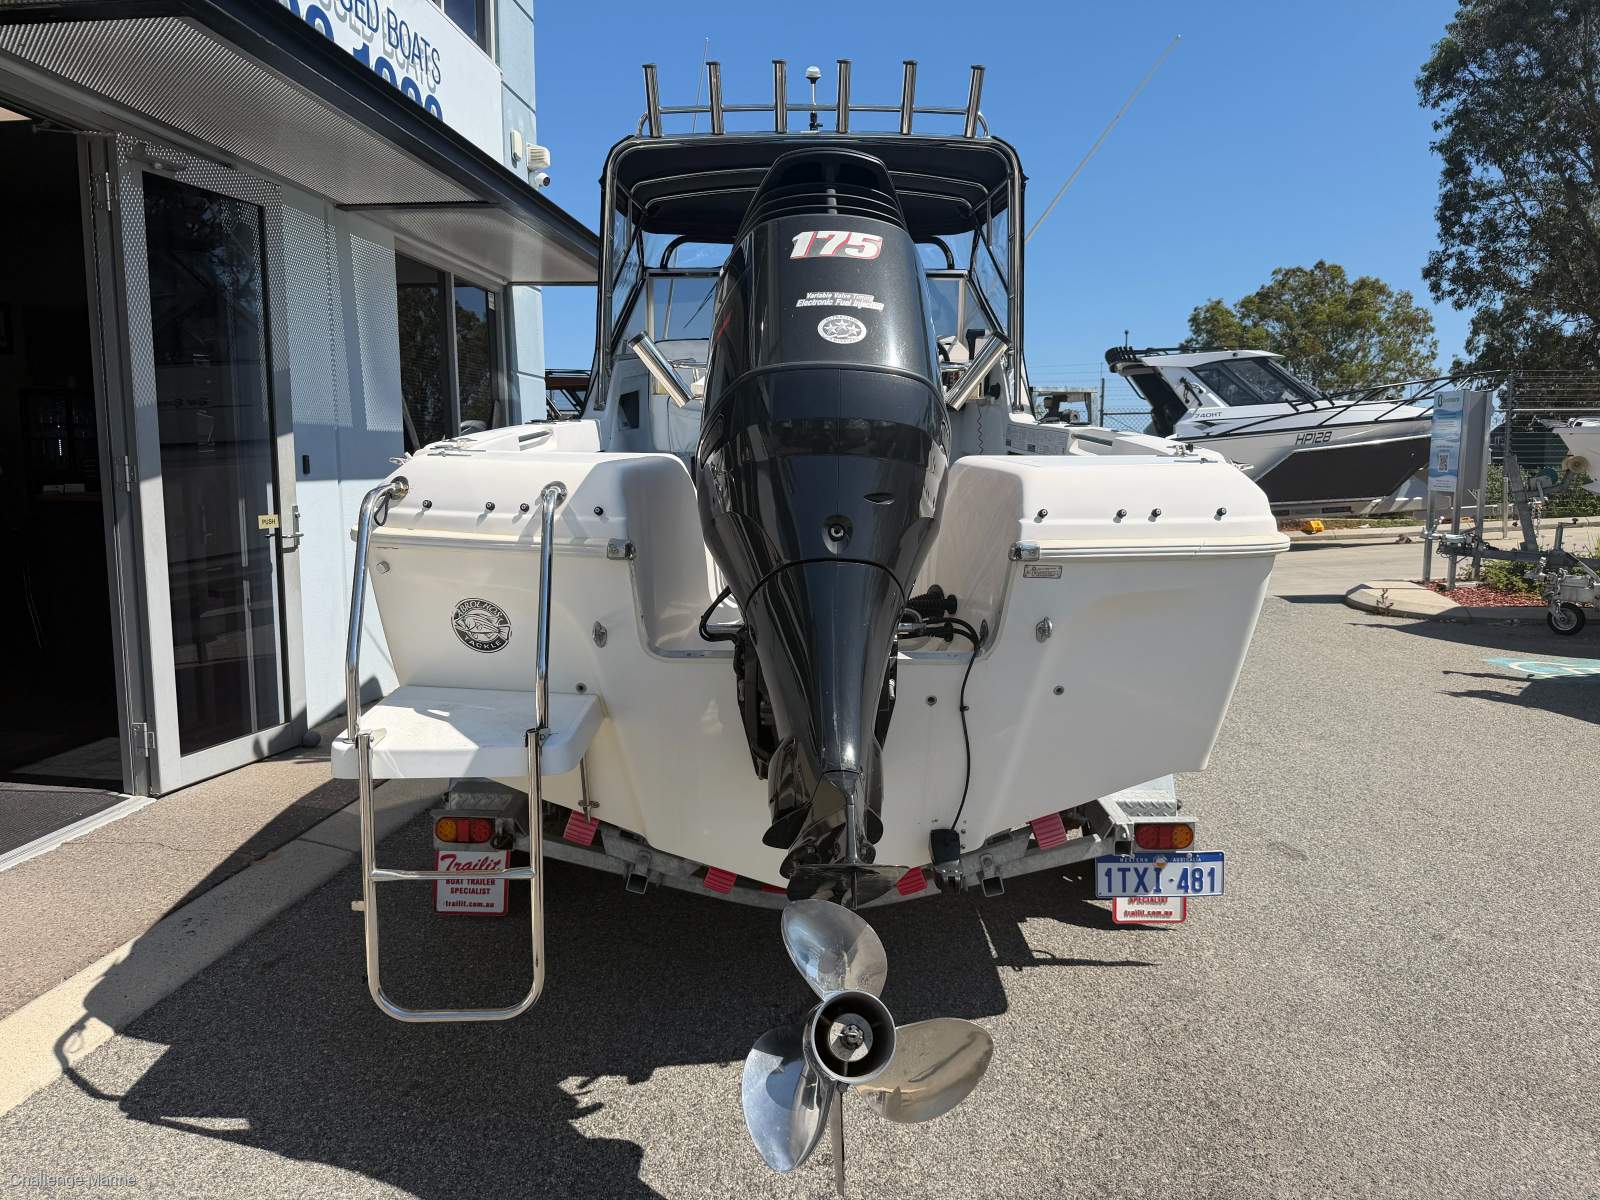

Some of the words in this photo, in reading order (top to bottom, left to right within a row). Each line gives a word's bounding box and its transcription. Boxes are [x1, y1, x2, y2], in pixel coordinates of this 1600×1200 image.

[387, 7, 441, 85] BOATS
[790, 230, 883, 260] 175
[796, 299, 833, 307] Electronic
[835, 299, 852, 307] Fuel
[1194, 411, 1223, 419] 740HT
[1295, 431, 1333, 446] HP128
[465, 635, 502, 650] TACKLE
[440, 854, 502, 871] Trailit
[450, 887, 491, 895] SPECIALIST
[445, 900, 495, 908] trailit.com.au
